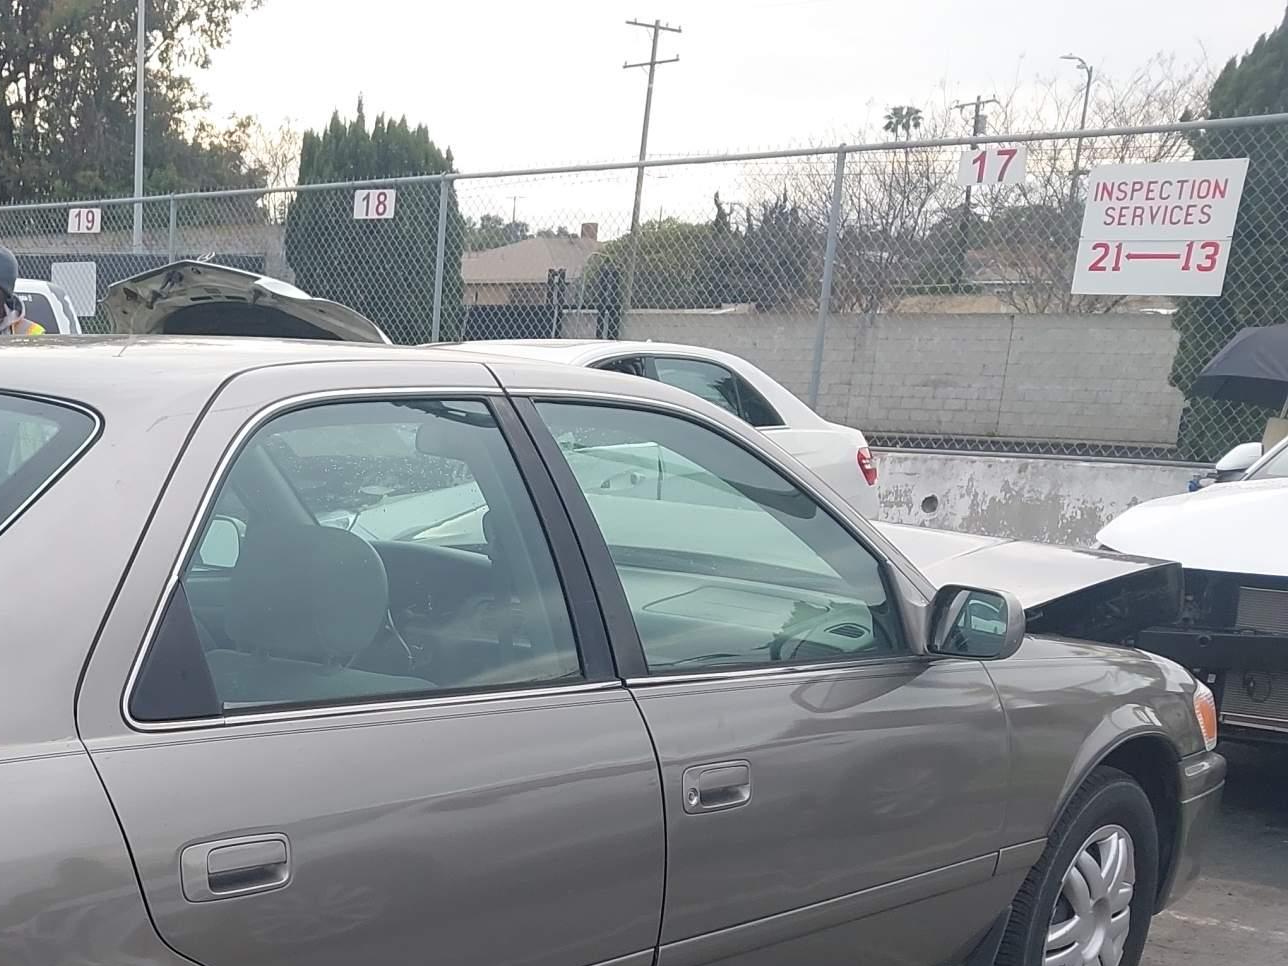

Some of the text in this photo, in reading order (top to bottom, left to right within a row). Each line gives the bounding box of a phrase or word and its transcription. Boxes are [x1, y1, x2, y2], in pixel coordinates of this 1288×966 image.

[971, 148, 1018, 184] 17
[1093, 178, 1229, 202] INSPECTION
[361, 191, 388, 217] 18
[1103, 204, 1213, 226] SERVICES
[74, 209, 96, 232] 19
[1087, 241, 1221, 272] 21 13
